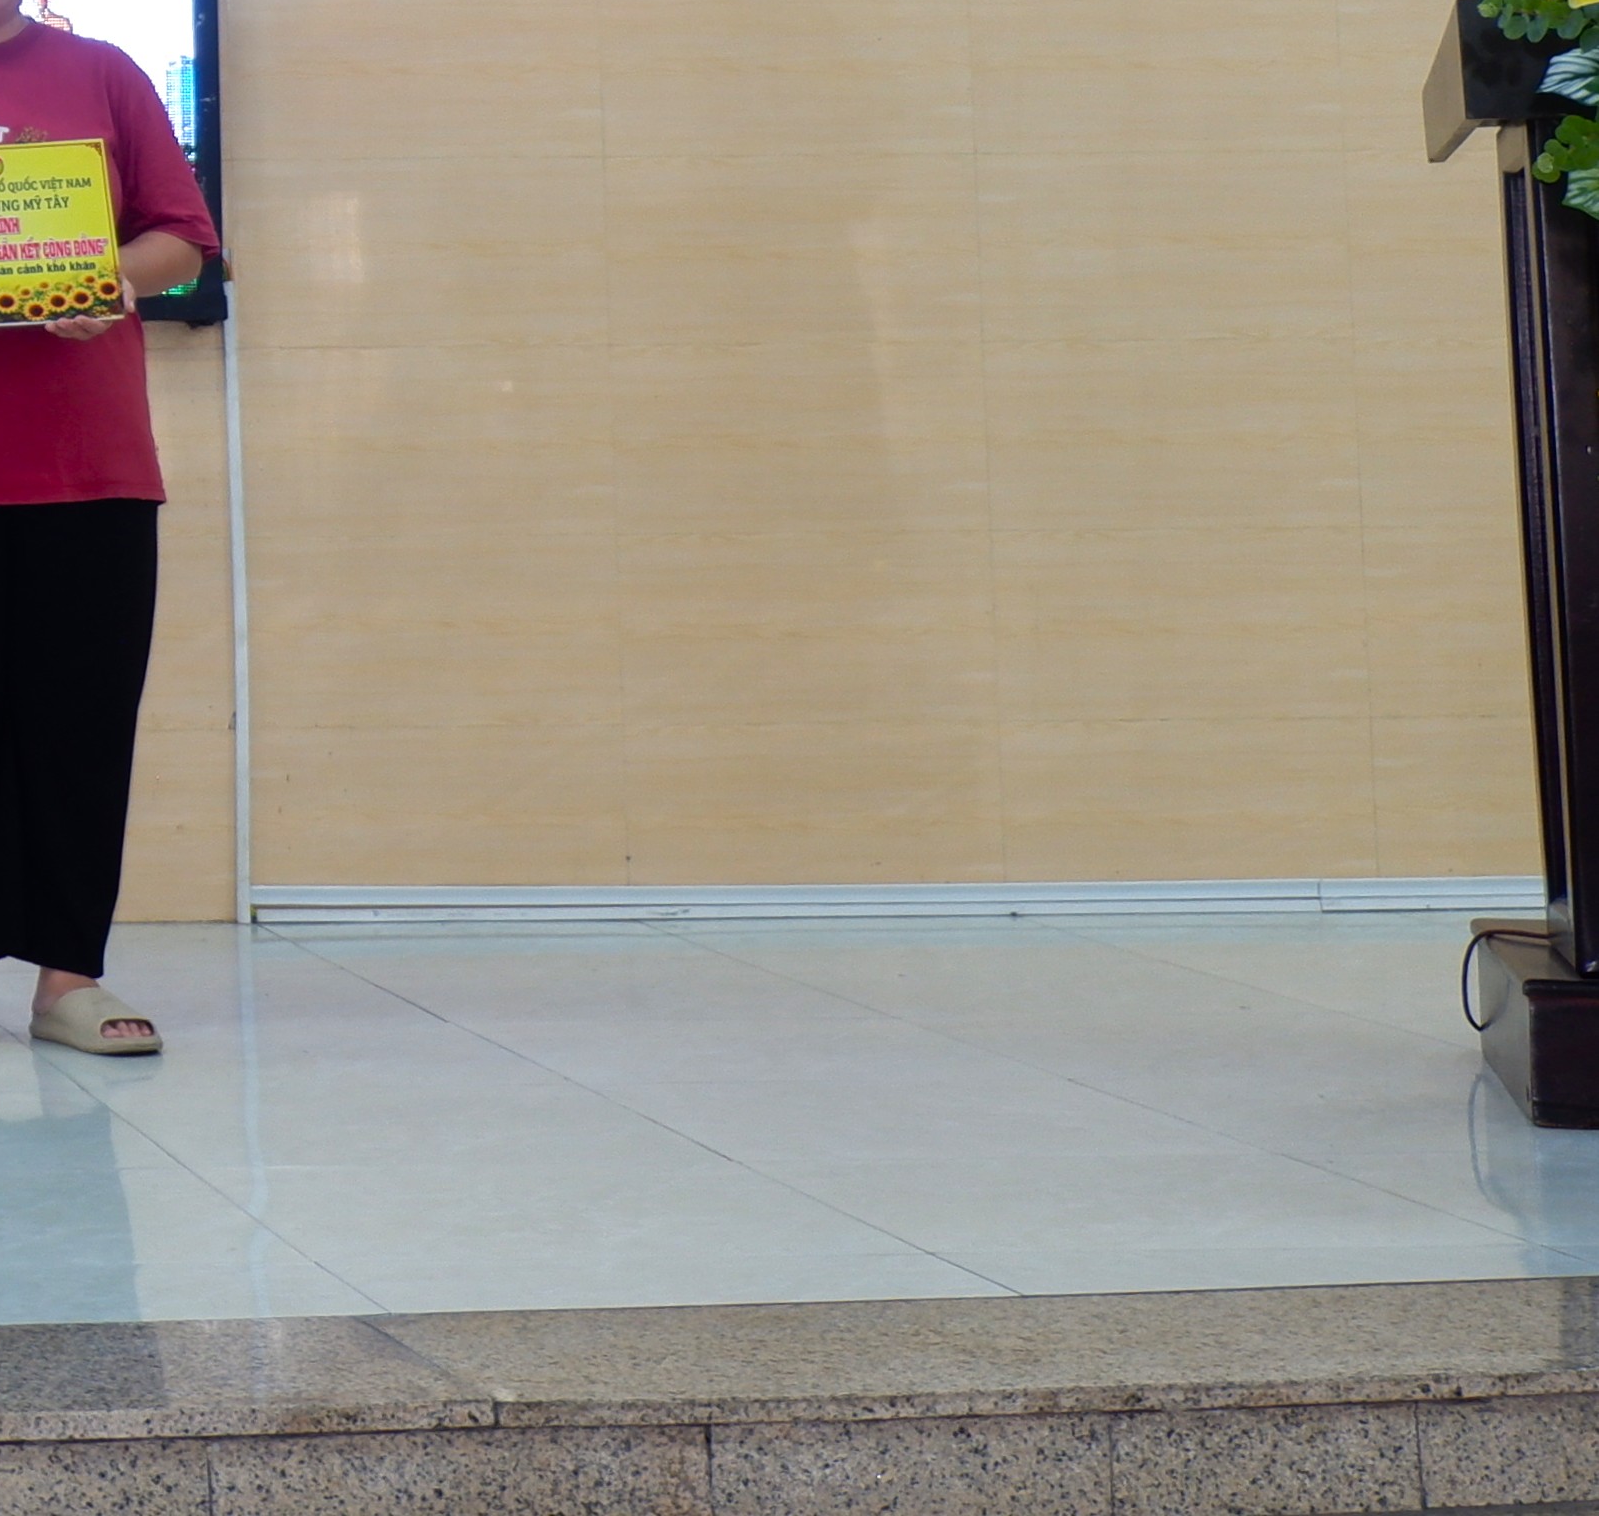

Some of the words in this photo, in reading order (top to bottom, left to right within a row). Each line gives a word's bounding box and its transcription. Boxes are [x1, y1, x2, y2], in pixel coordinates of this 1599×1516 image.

[65, 177, 92, 189] NAM
[23, 195, 42, 211] MỸ
[44, 194, 70, 210] TÂY
